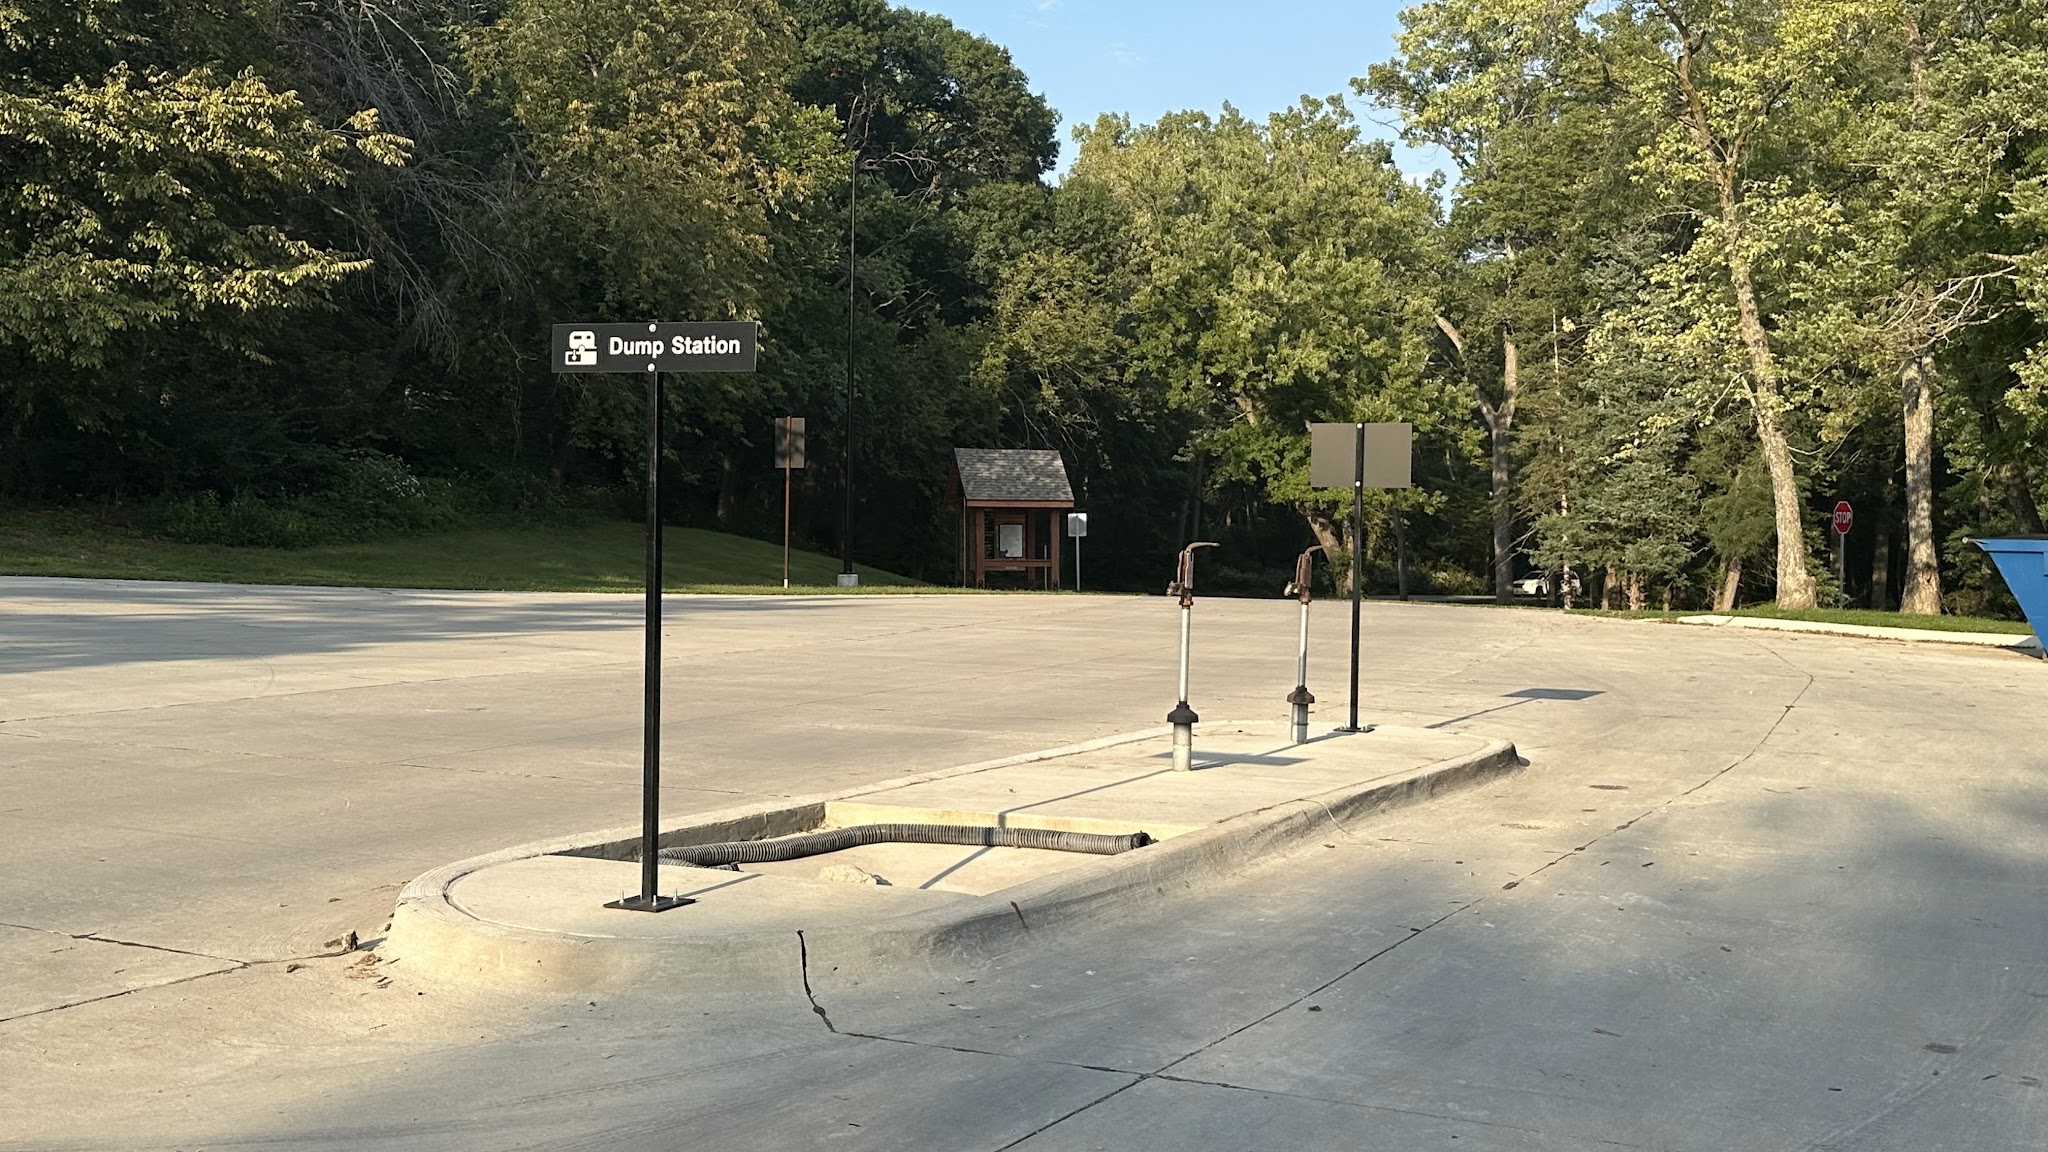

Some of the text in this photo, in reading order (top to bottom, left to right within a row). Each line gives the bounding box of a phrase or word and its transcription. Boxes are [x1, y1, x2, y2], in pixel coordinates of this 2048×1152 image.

[609, 335, 741, 358] Dump Station
[1835, 511, 1851, 524] STOP
